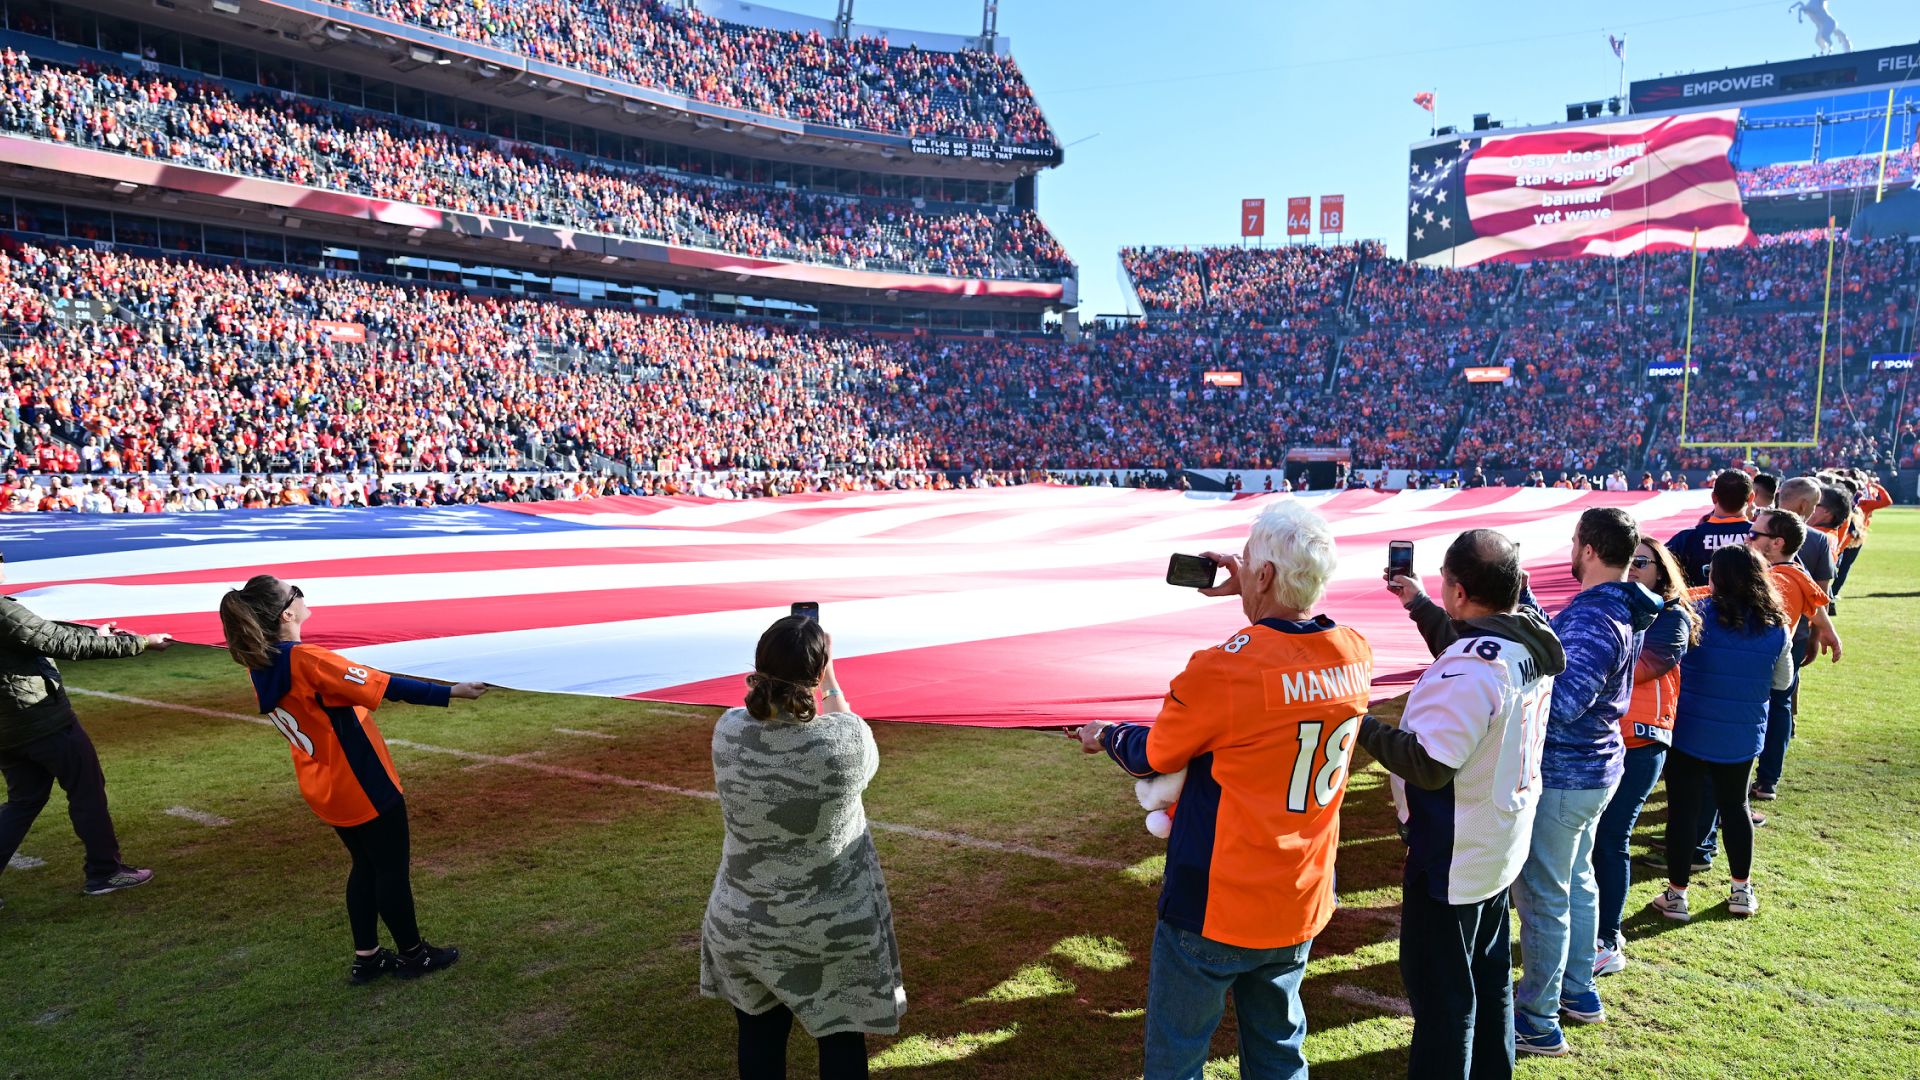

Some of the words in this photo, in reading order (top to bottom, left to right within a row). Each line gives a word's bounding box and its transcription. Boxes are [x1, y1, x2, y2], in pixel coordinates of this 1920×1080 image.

[1683, 73, 1774, 97] EMPOWER
[1878, 55, 1920, 71] FIEL
[931, 140, 950, 148] FLAG
[972, 144, 995, 152] STILL
[1509, 156, 1522, 168] O
[1528, 154, 1556, 167] say
[1561, 150, 1602, 164] does
[1608, 142, 1646, 158] that
[995, 152, 1013, 160] THAT
[1515, 162, 1635, 187] star-spangled
[1542, 190, 1604, 207] banner
[1248, 215, 1258, 231] 7
[1288, 212, 1310, 229] 44
[1323, 211, 1340, 228] 18
[1533, 210, 1561, 227] yet
[1565, 208, 1612, 223] wave
[1649, 367, 1699, 376] EMPOWR
[1703, 534, 1749, 549] ELWA
[1217, 634, 1250, 653] 8
[1463, 639, 1502, 661] 18
[344, 666, 368, 685] 18
[1286, 715, 1361, 813] 18
